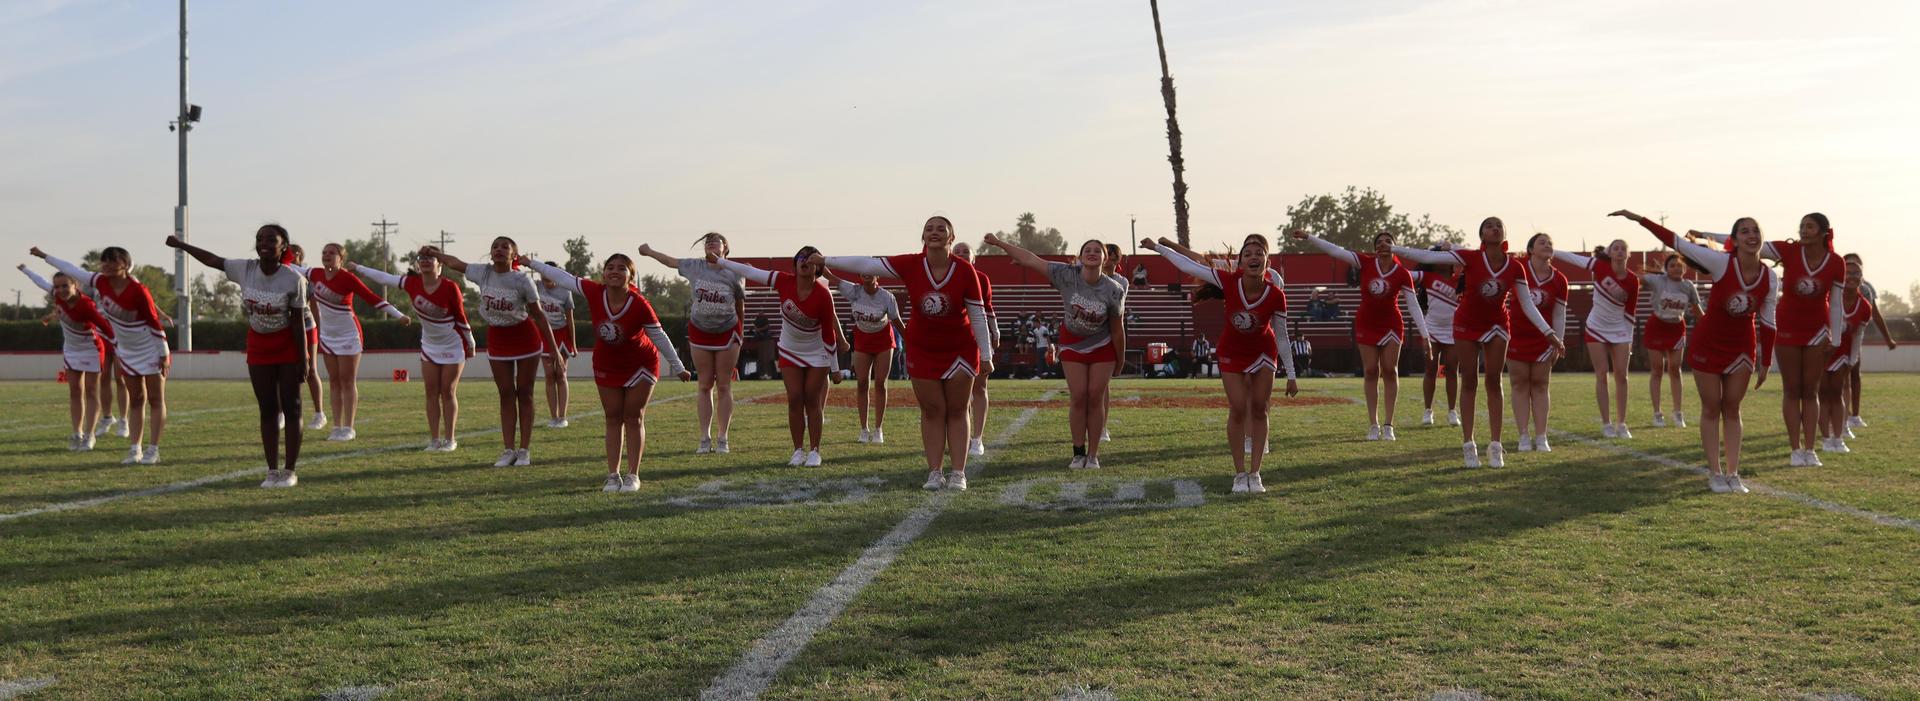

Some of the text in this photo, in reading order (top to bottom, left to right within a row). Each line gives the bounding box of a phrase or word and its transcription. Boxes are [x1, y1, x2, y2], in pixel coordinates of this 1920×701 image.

[483, 295, 514, 312] Tribe
[695, 288, 726, 304] Tribe
[394, 369, 407, 380] 30
